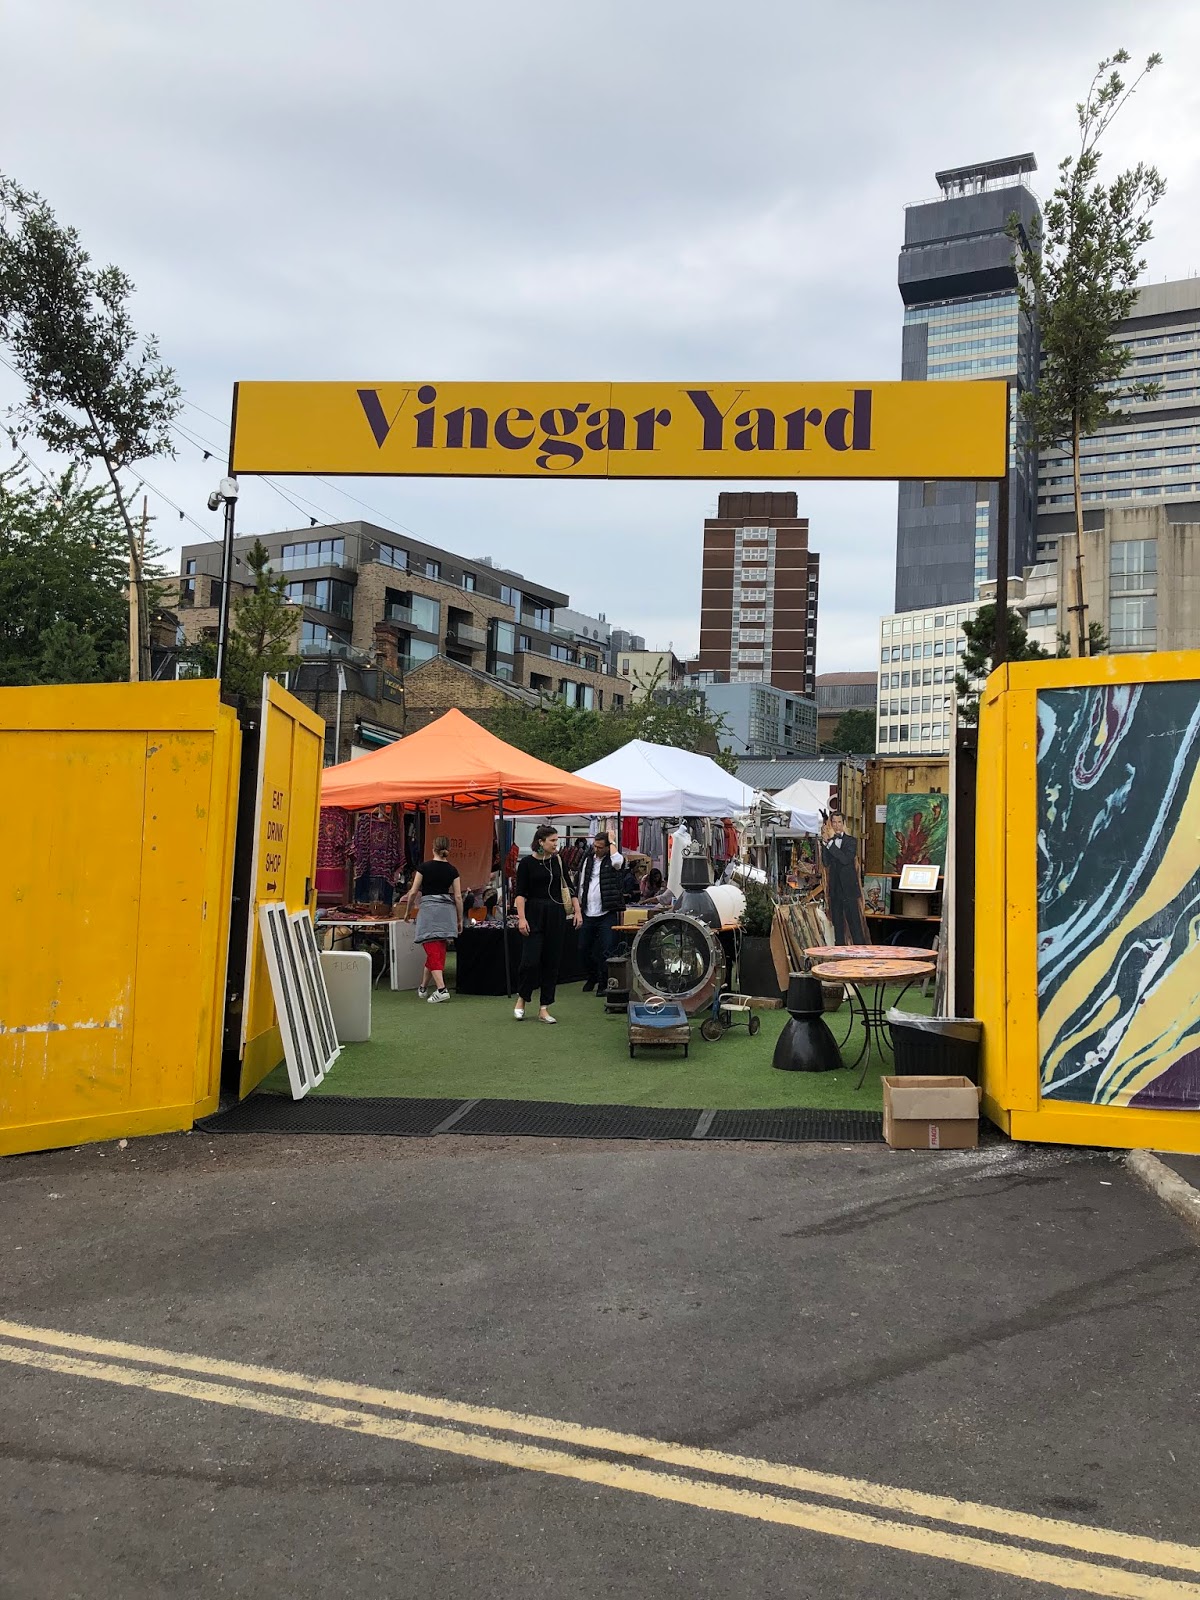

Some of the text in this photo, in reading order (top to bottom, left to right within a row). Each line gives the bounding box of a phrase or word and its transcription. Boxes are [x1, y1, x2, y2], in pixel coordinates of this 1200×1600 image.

[356, 385, 875, 470] Vinegar Yard
[273, 790, 283, 811] EAT
[267, 821, 284, 842] DRINK
[266, 853, 281, 872] SHOP
